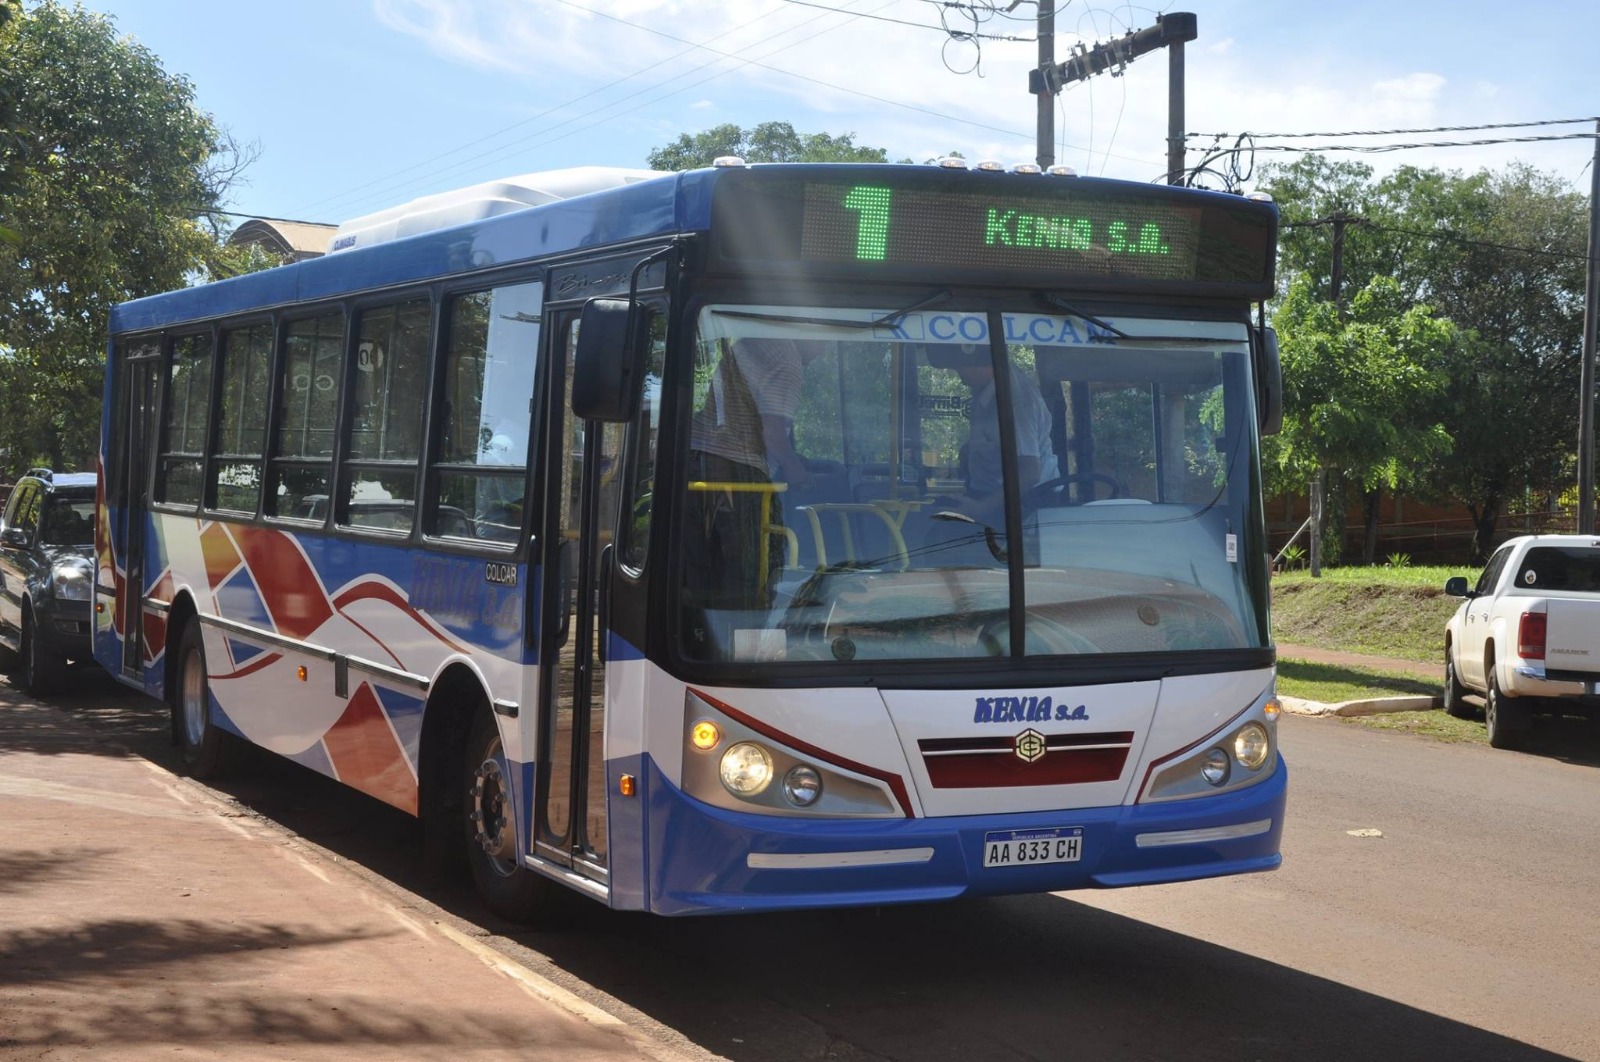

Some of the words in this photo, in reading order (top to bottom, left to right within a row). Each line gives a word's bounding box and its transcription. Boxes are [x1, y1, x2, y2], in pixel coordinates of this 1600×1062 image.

[844, 185, 891, 260] 1
[985, 207, 1092, 251] KENIA
[1107, 220, 1169, 254] S.A.
[486, 563, 517, 584] COLCAR
[974, 696, 1053, 723] KENIA
[989, 844, 1010, 863] AA
[1017, 841, 1051, 861] 833
[1056, 839, 1078, 859] CH
